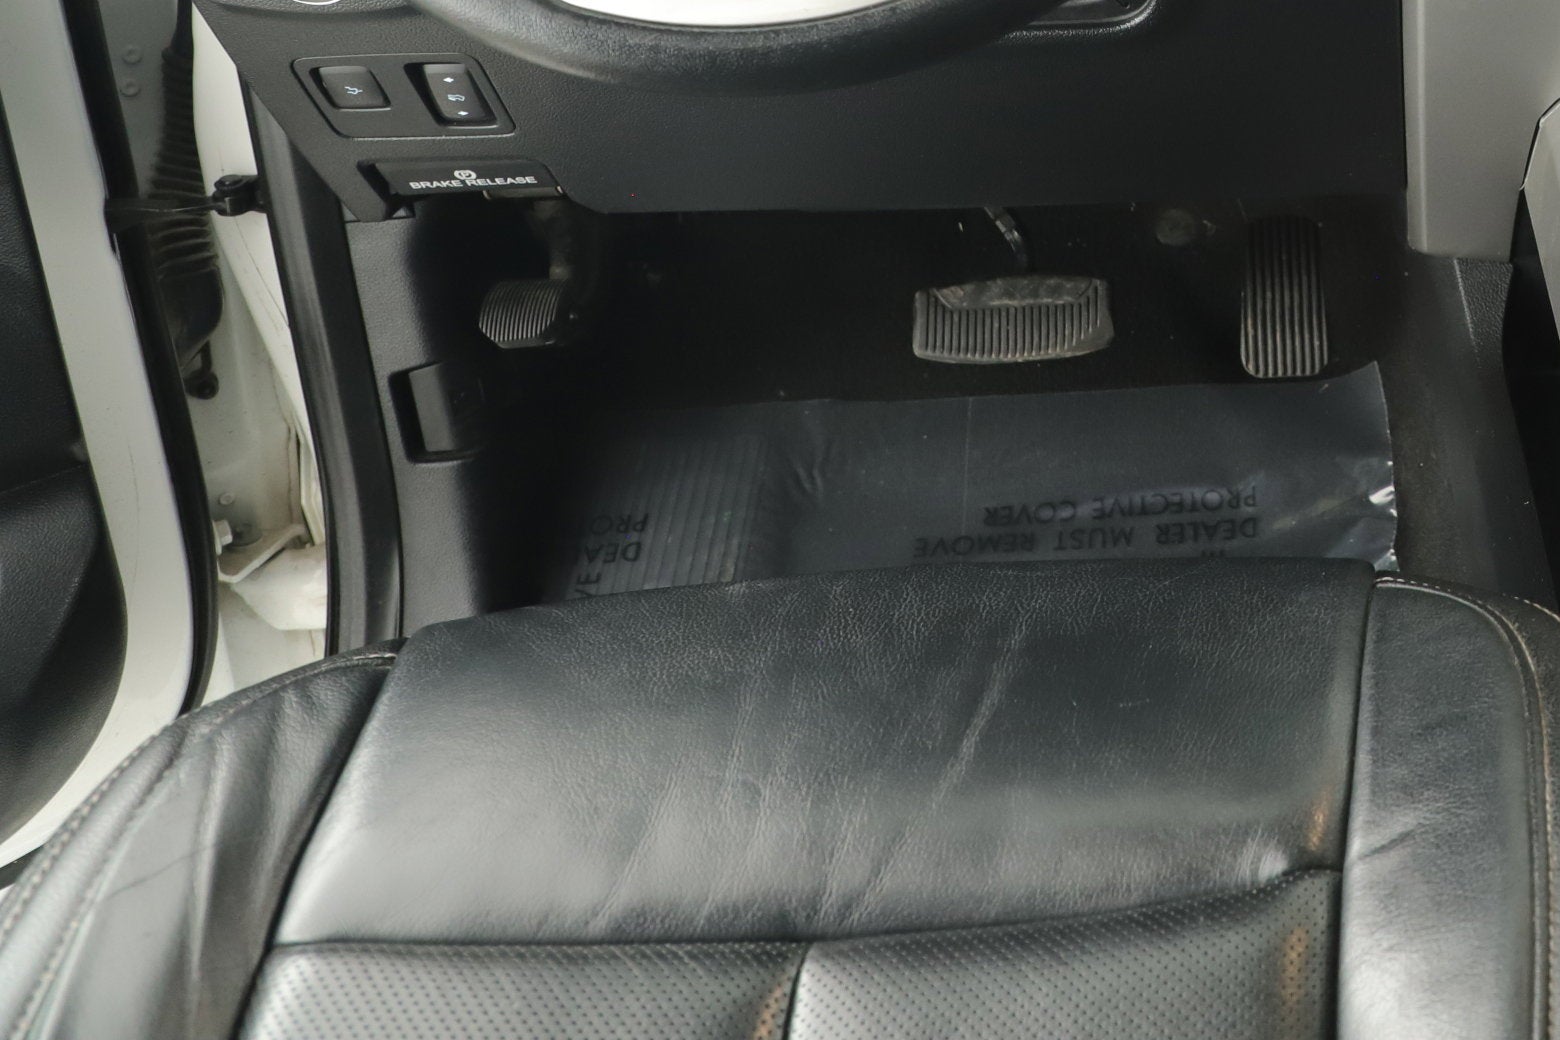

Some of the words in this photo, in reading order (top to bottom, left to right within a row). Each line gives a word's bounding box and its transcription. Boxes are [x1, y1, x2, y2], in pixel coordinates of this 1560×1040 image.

[409, 179, 463, 189] BRAKE
[465, 176, 538, 187] RELEASE
[983, 499, 1077, 528] COVER
[1091, 486, 1257, 521] PROTECTIVE
[590, 512, 650, 537] PRO
[1154, 517, 1259, 545] DEALER
[912, 532, 1036, 558] REMOVE
[1054, 526, 1136, 551] MUST
[583, 541, 641, 564] DEA
